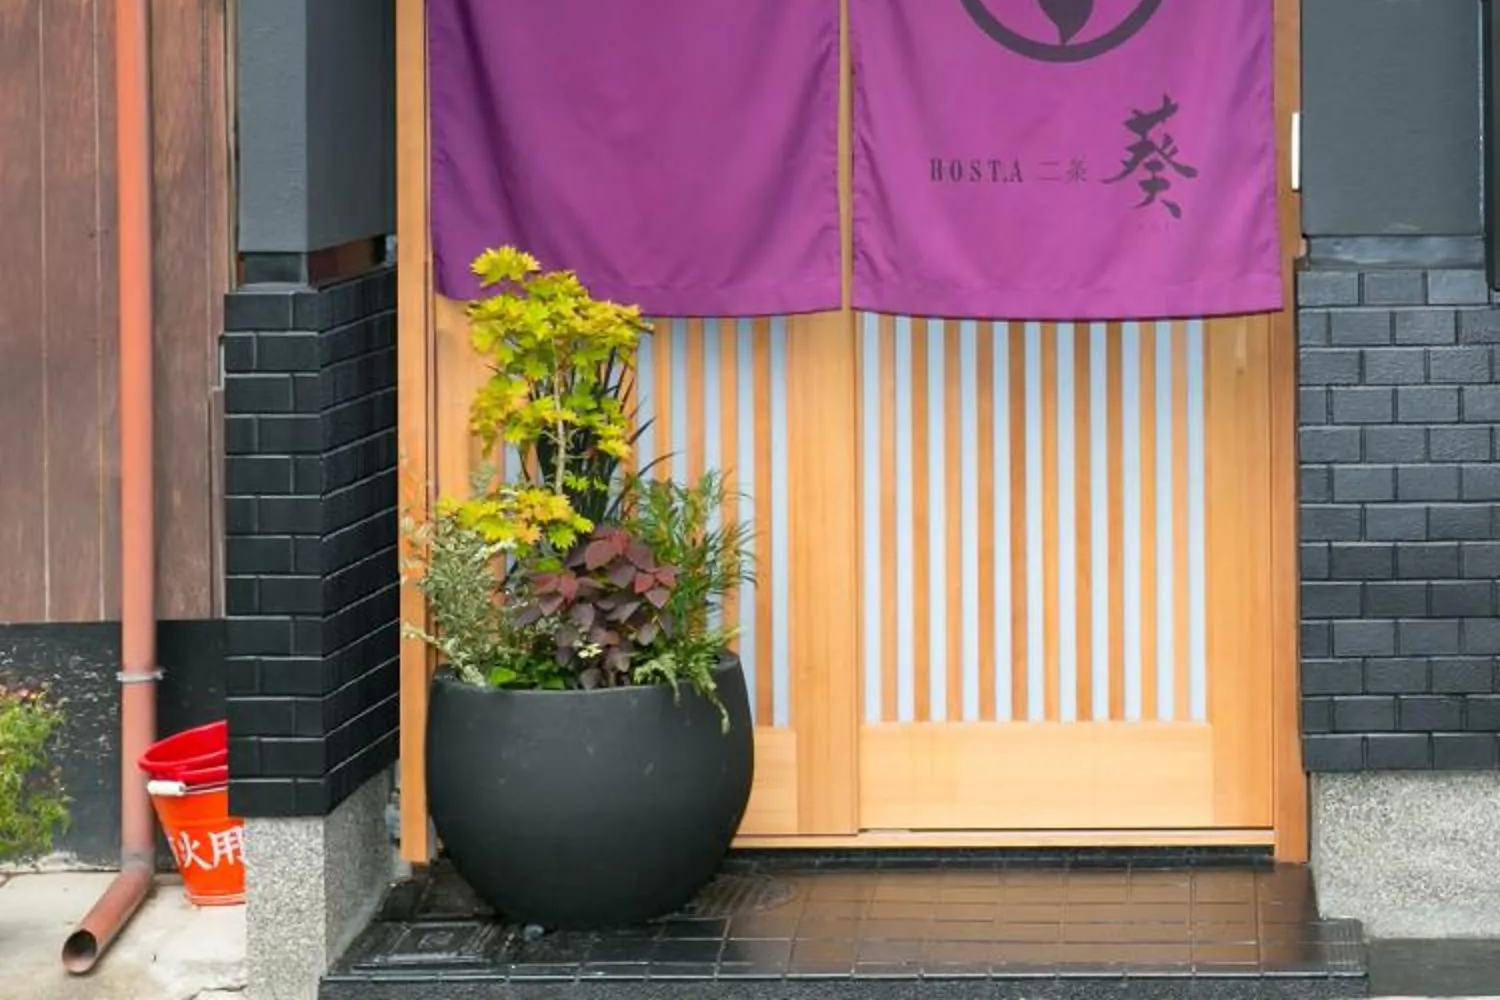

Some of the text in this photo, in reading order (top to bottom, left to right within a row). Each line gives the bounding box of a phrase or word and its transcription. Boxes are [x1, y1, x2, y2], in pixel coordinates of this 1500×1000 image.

[929, 93, 1198, 219] HOSTA 二条 葵
[168, 826, 246, 870] 火用
